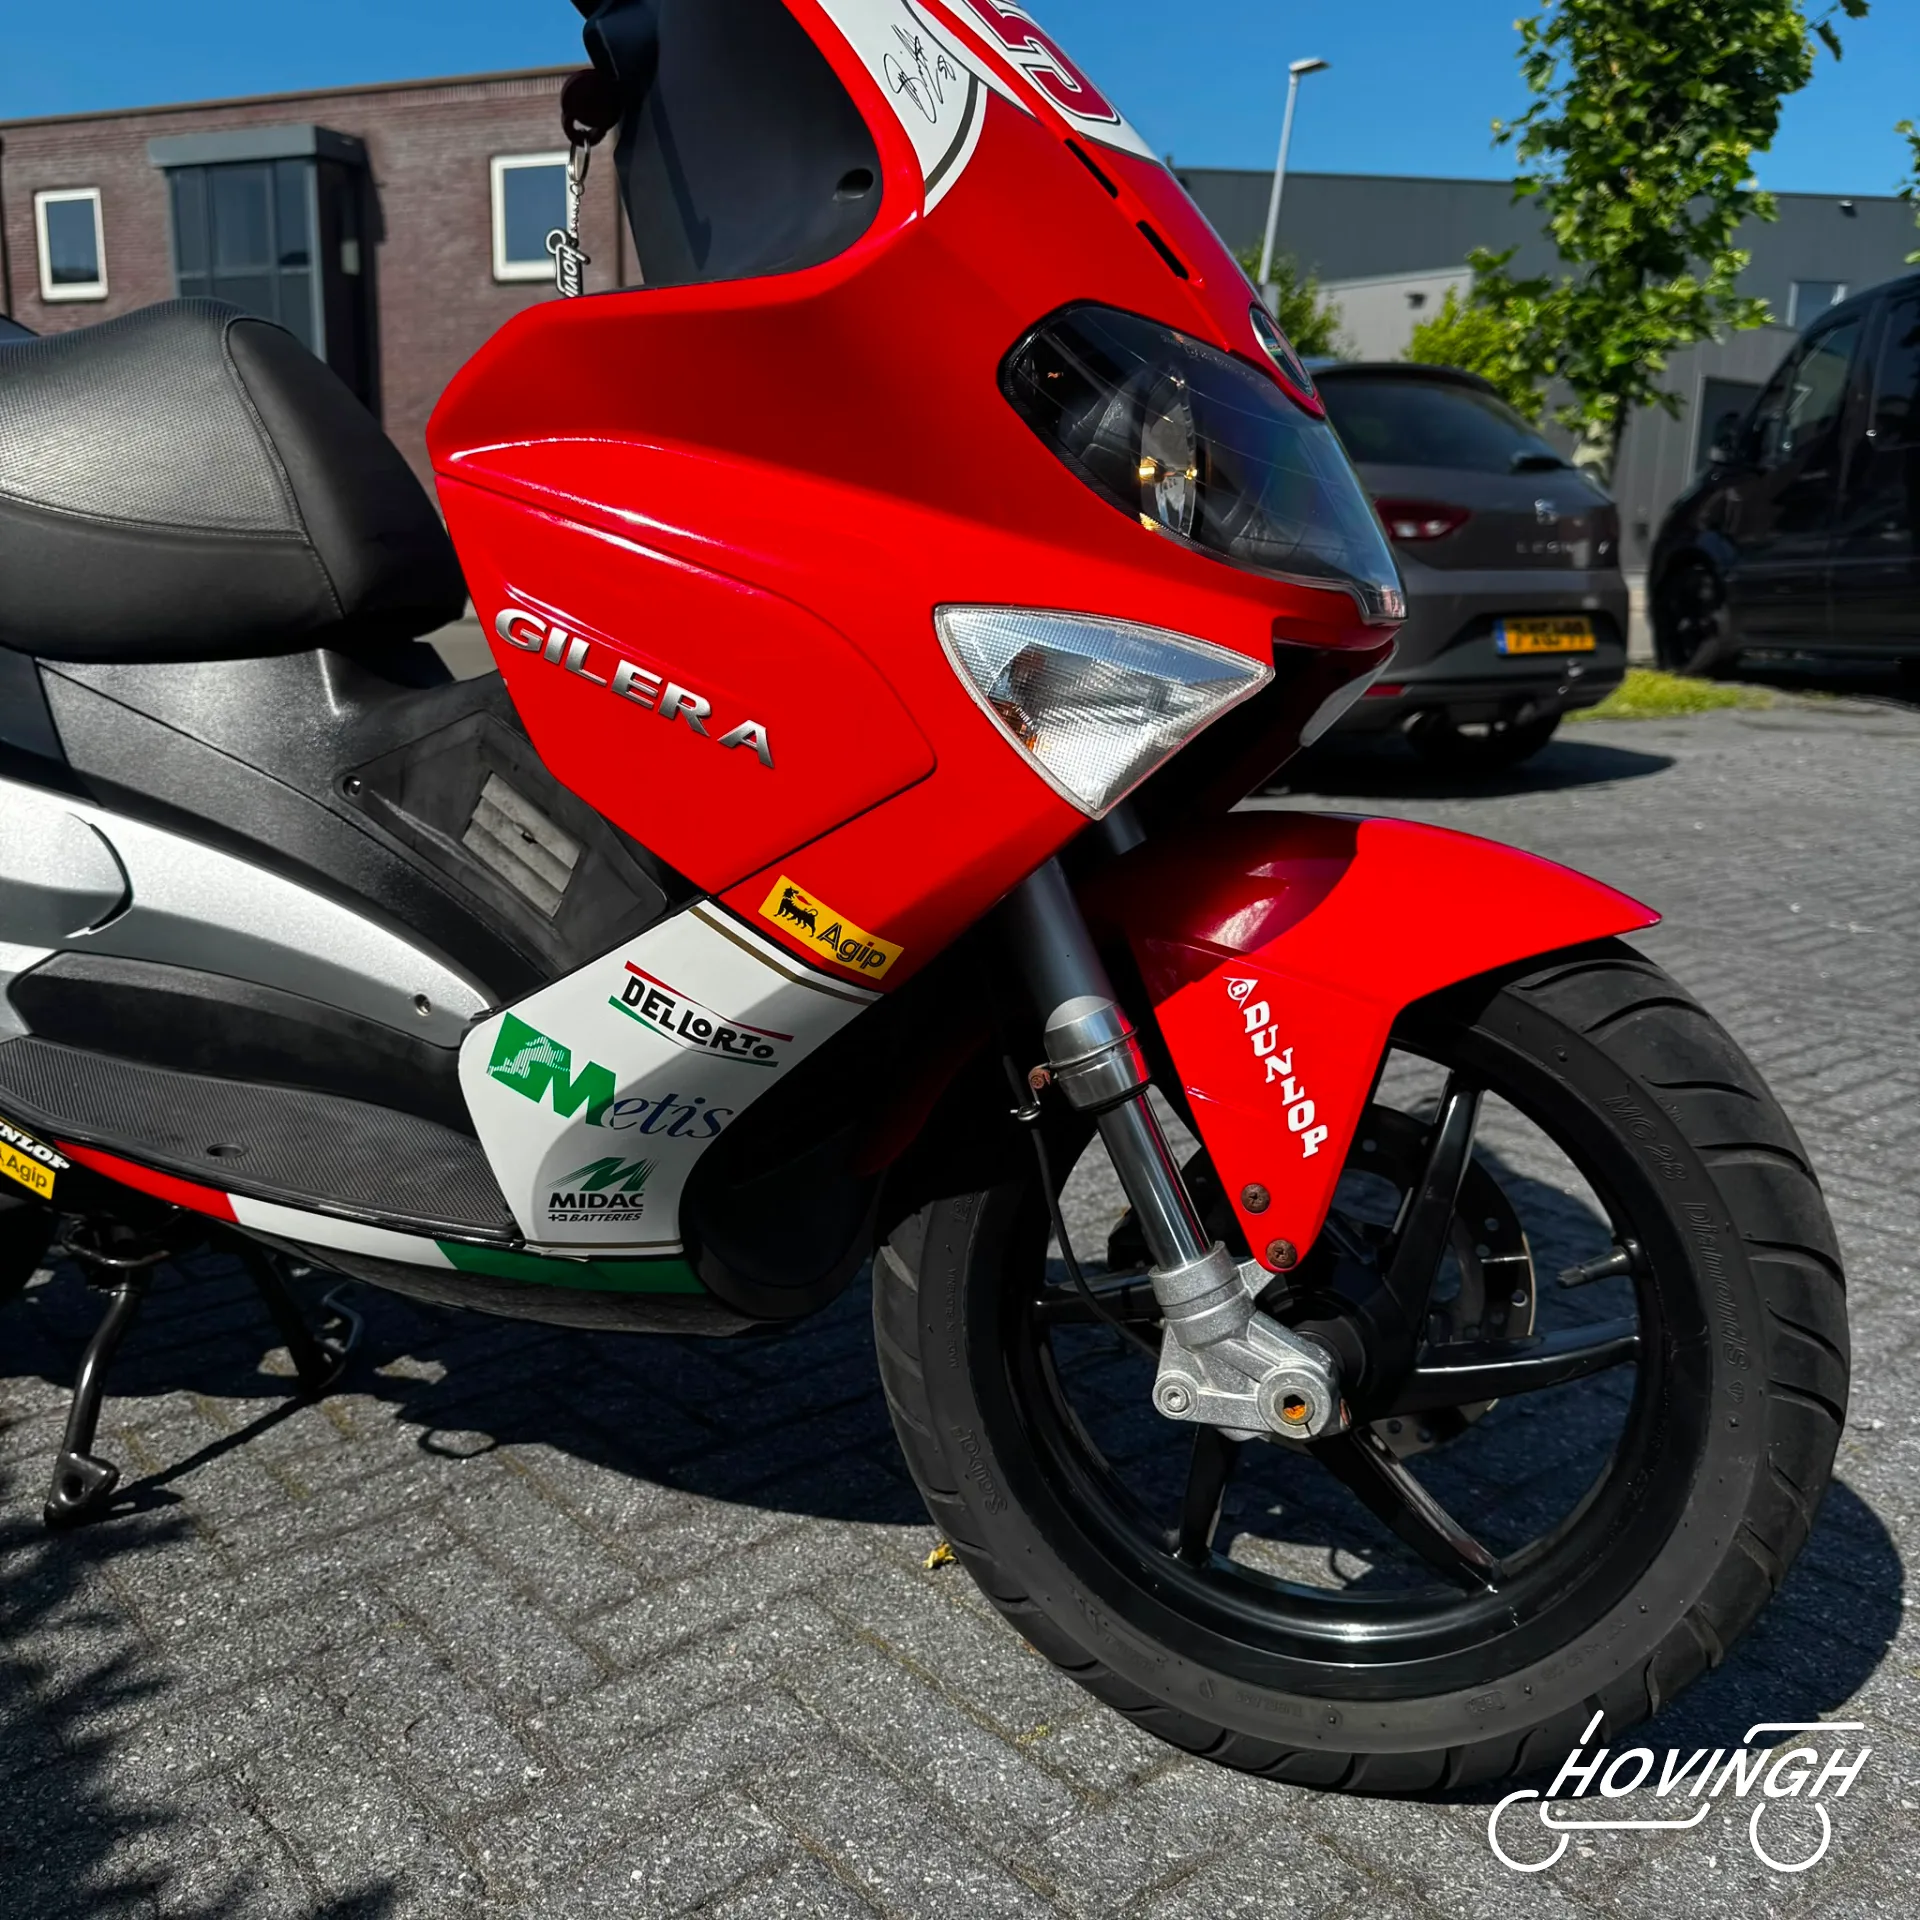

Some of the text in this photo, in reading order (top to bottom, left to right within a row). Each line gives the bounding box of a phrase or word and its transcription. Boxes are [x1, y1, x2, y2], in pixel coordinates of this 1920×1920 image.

[494, 607, 775, 769] GILERA
[816, 921, 887, 969] Agip
[1243, 1000, 1328, 1159] DUNLOP
[1602, 1093, 1657, 1140] MC
[6, 1154, 48, 1188] Agip
[548, 1192, 645, 1209] MIDAC
[569, 1212, 642, 1222] BATTERIES
